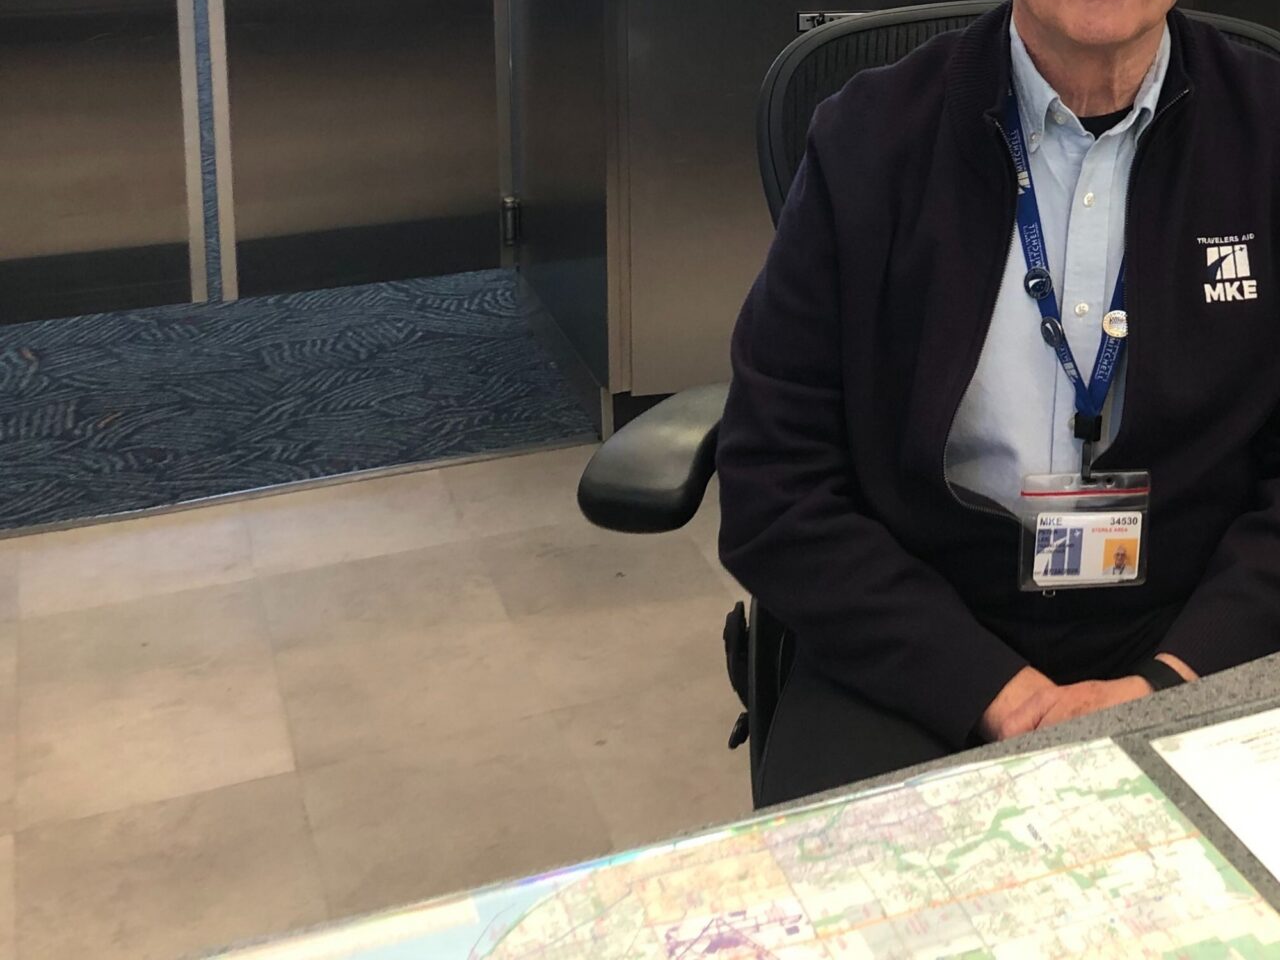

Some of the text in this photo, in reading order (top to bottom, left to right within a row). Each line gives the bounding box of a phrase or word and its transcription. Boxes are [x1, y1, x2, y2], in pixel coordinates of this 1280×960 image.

[1028, 223, 1041, 268] MITCHELL
[1197, 233, 1255, 244] TRAVELERS AID
[1203, 279, 1258, 303] MKE
[1040, 517, 1138, 526] MKE 34530
